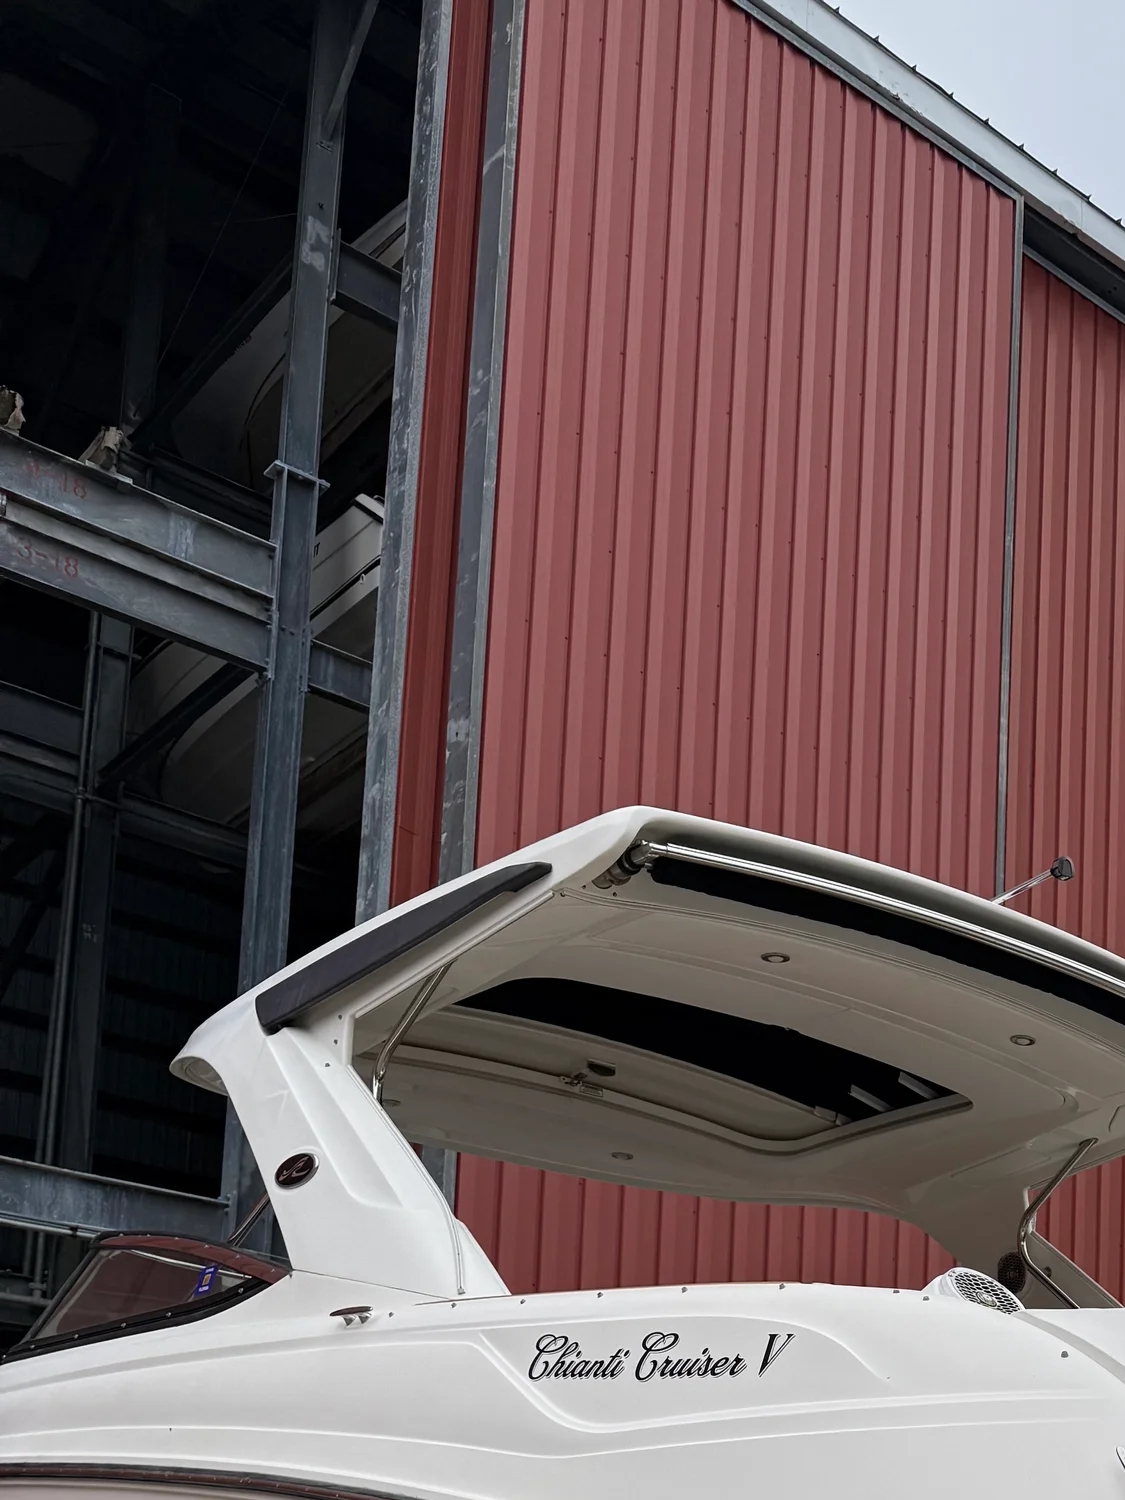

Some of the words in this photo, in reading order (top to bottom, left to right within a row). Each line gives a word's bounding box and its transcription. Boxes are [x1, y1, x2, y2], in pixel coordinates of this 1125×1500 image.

[527, 1333, 632, 1382] Chianti
[634, 1331, 748, 1383] Cruiser
[758, 1333, 795, 1378] V
